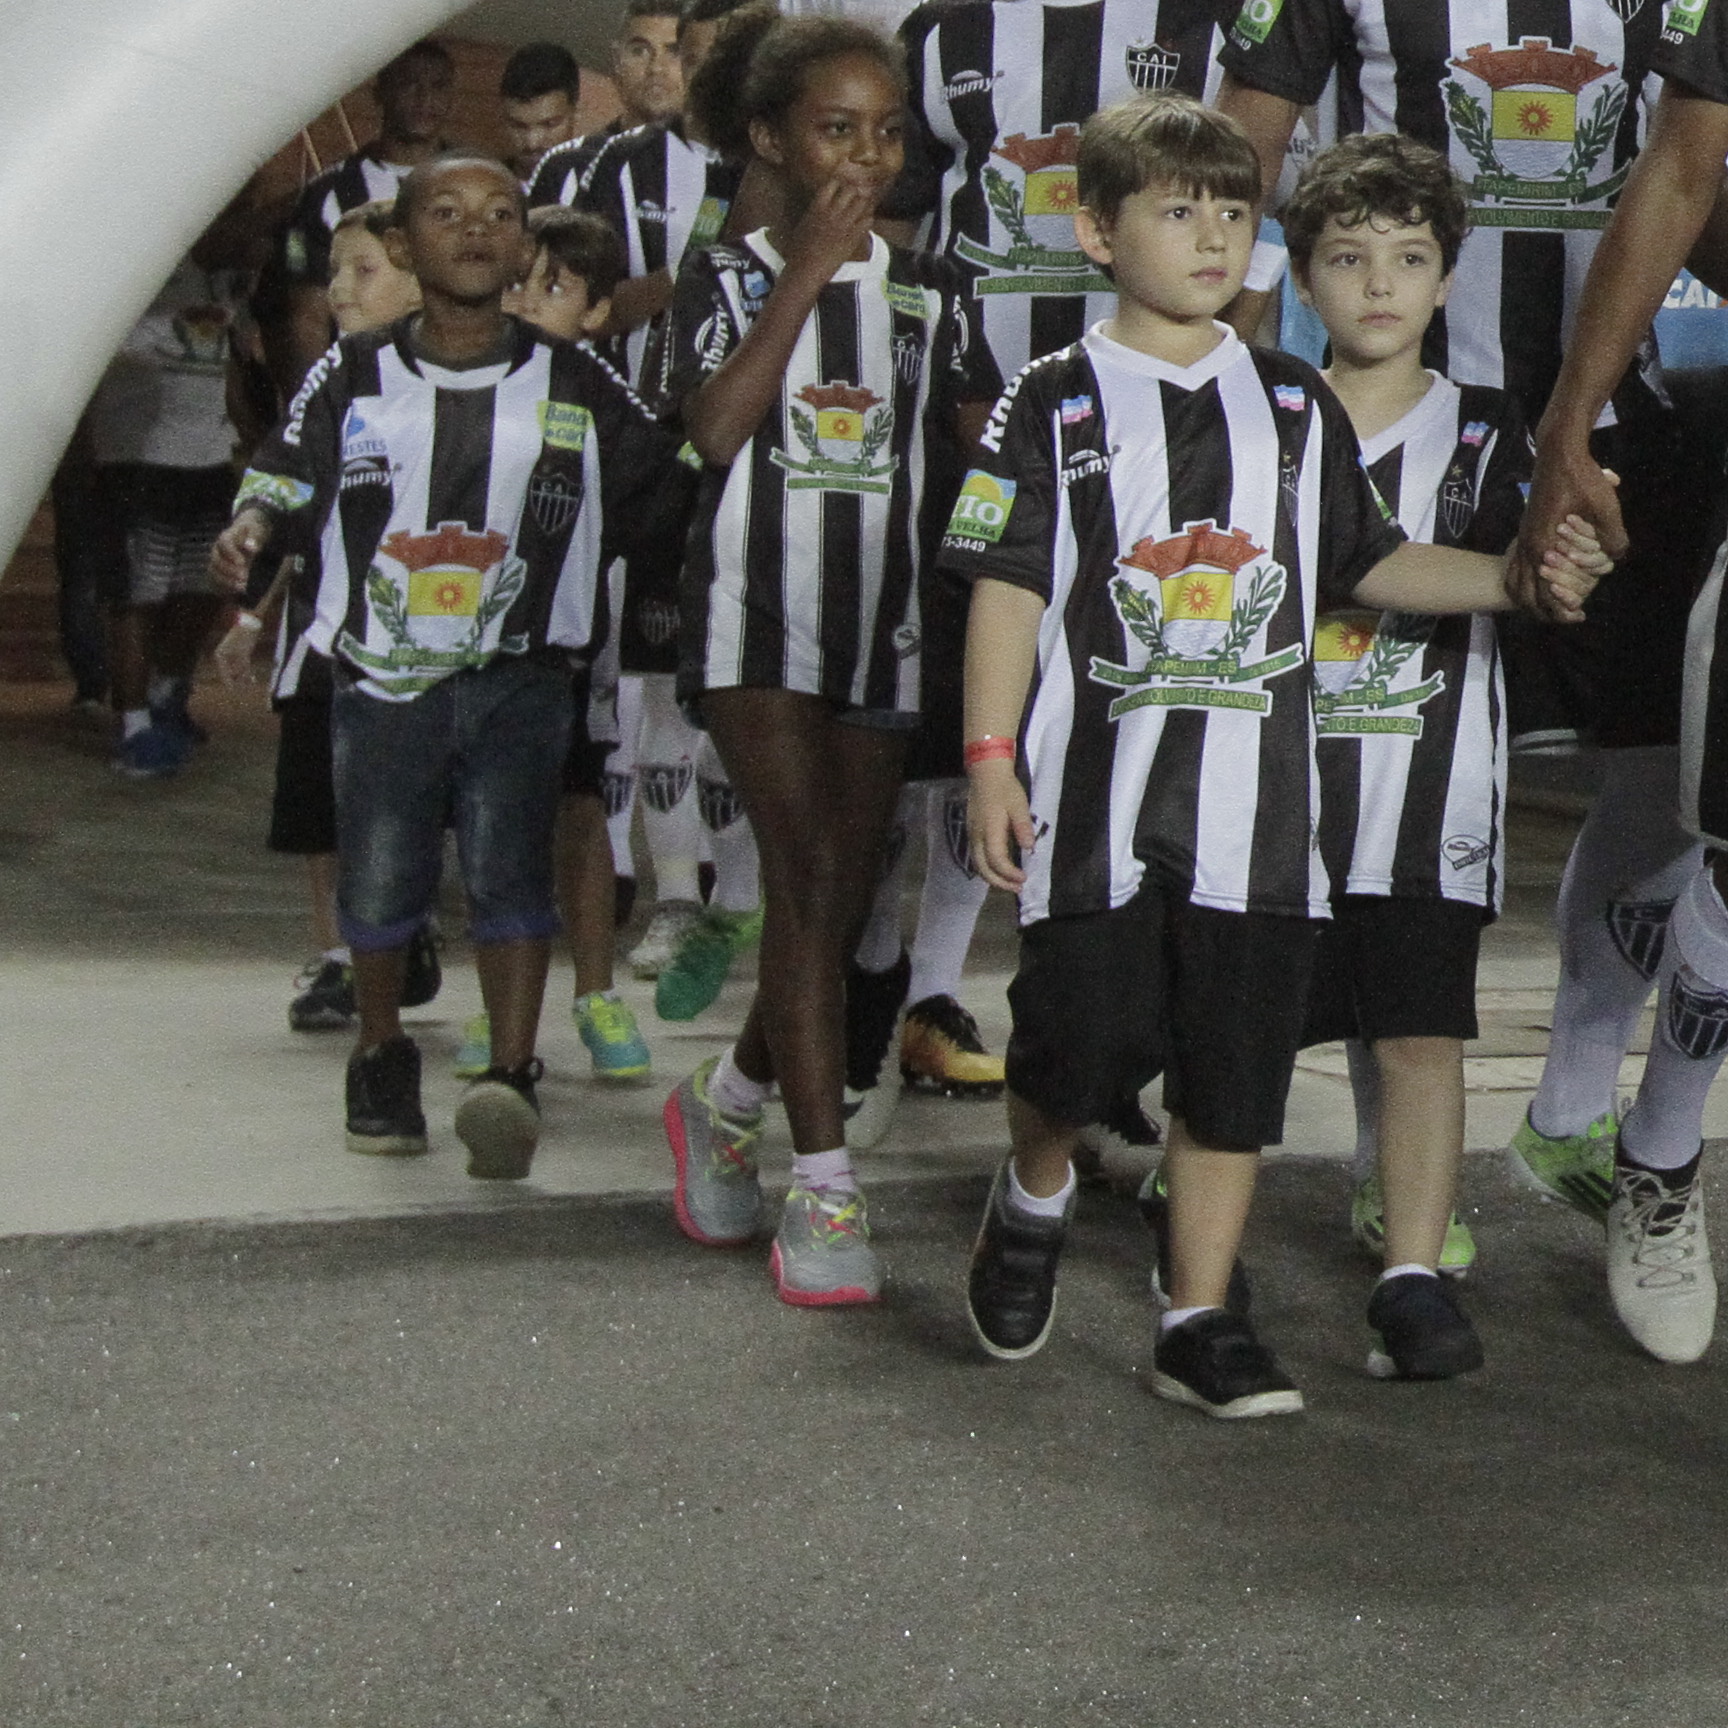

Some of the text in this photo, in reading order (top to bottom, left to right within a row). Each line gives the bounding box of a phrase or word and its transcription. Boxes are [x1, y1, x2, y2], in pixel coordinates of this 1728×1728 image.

[1136, 52, 1167, 64] CAI
[1209, 690, 1266, 710] GRANDEZA
[1359, 718, 1420, 733] GRANDEZA
